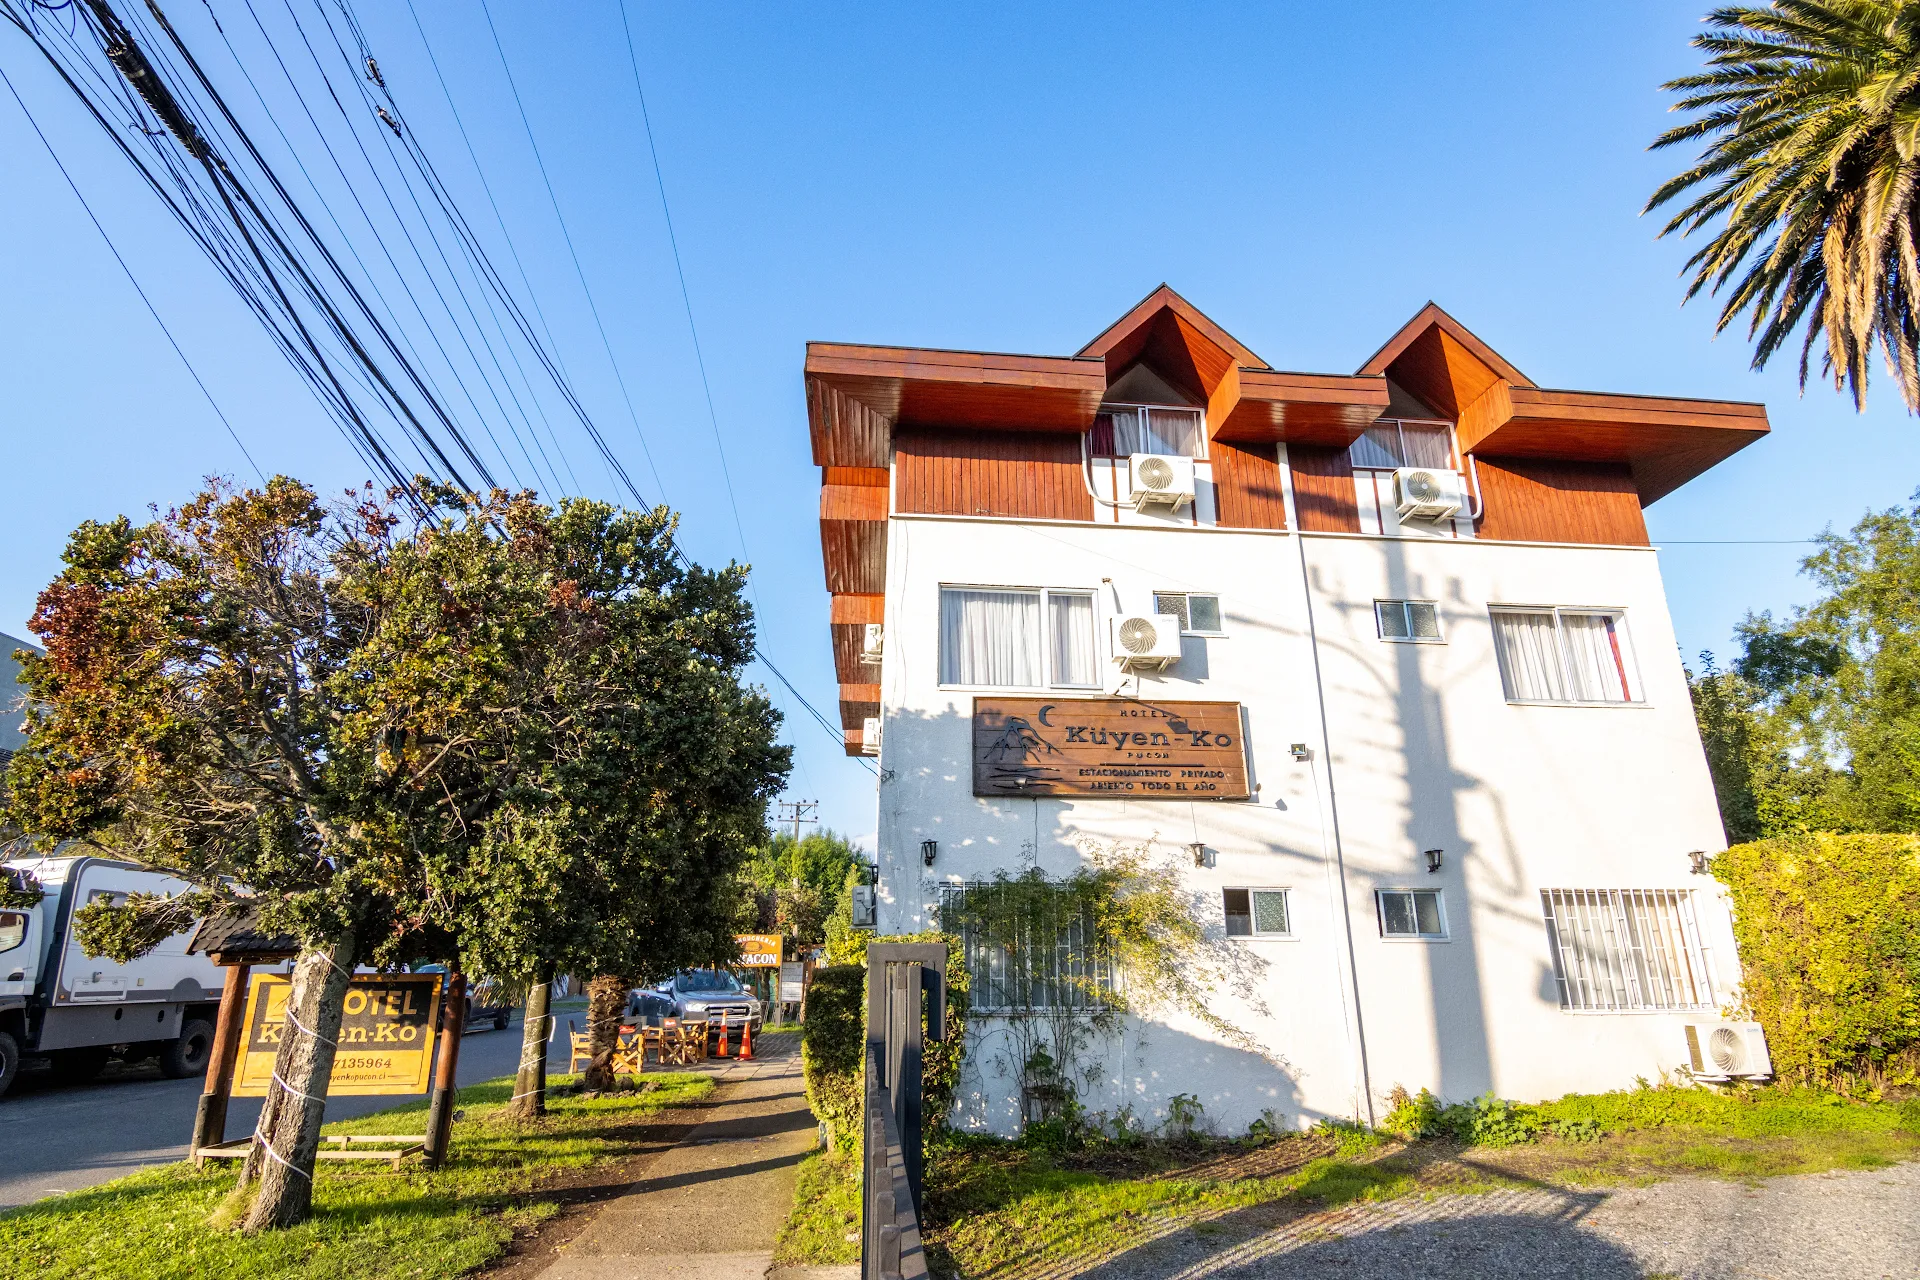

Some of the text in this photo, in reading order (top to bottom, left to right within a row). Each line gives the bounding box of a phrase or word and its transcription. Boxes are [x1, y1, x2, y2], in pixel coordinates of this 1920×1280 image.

[1119, 709, 1168, 718] HOTEL
[1078, 768, 1225, 779] ESTACIONAMIENTO PRIVADO
[1089, 781, 1217, 791] ABIERTO TODO EL AÑO
[343, 990, 417, 1015] OTEL
[333, 1057, 392, 1069] 7135964
[329, 1072, 386, 1083] yenkopucon.cl
